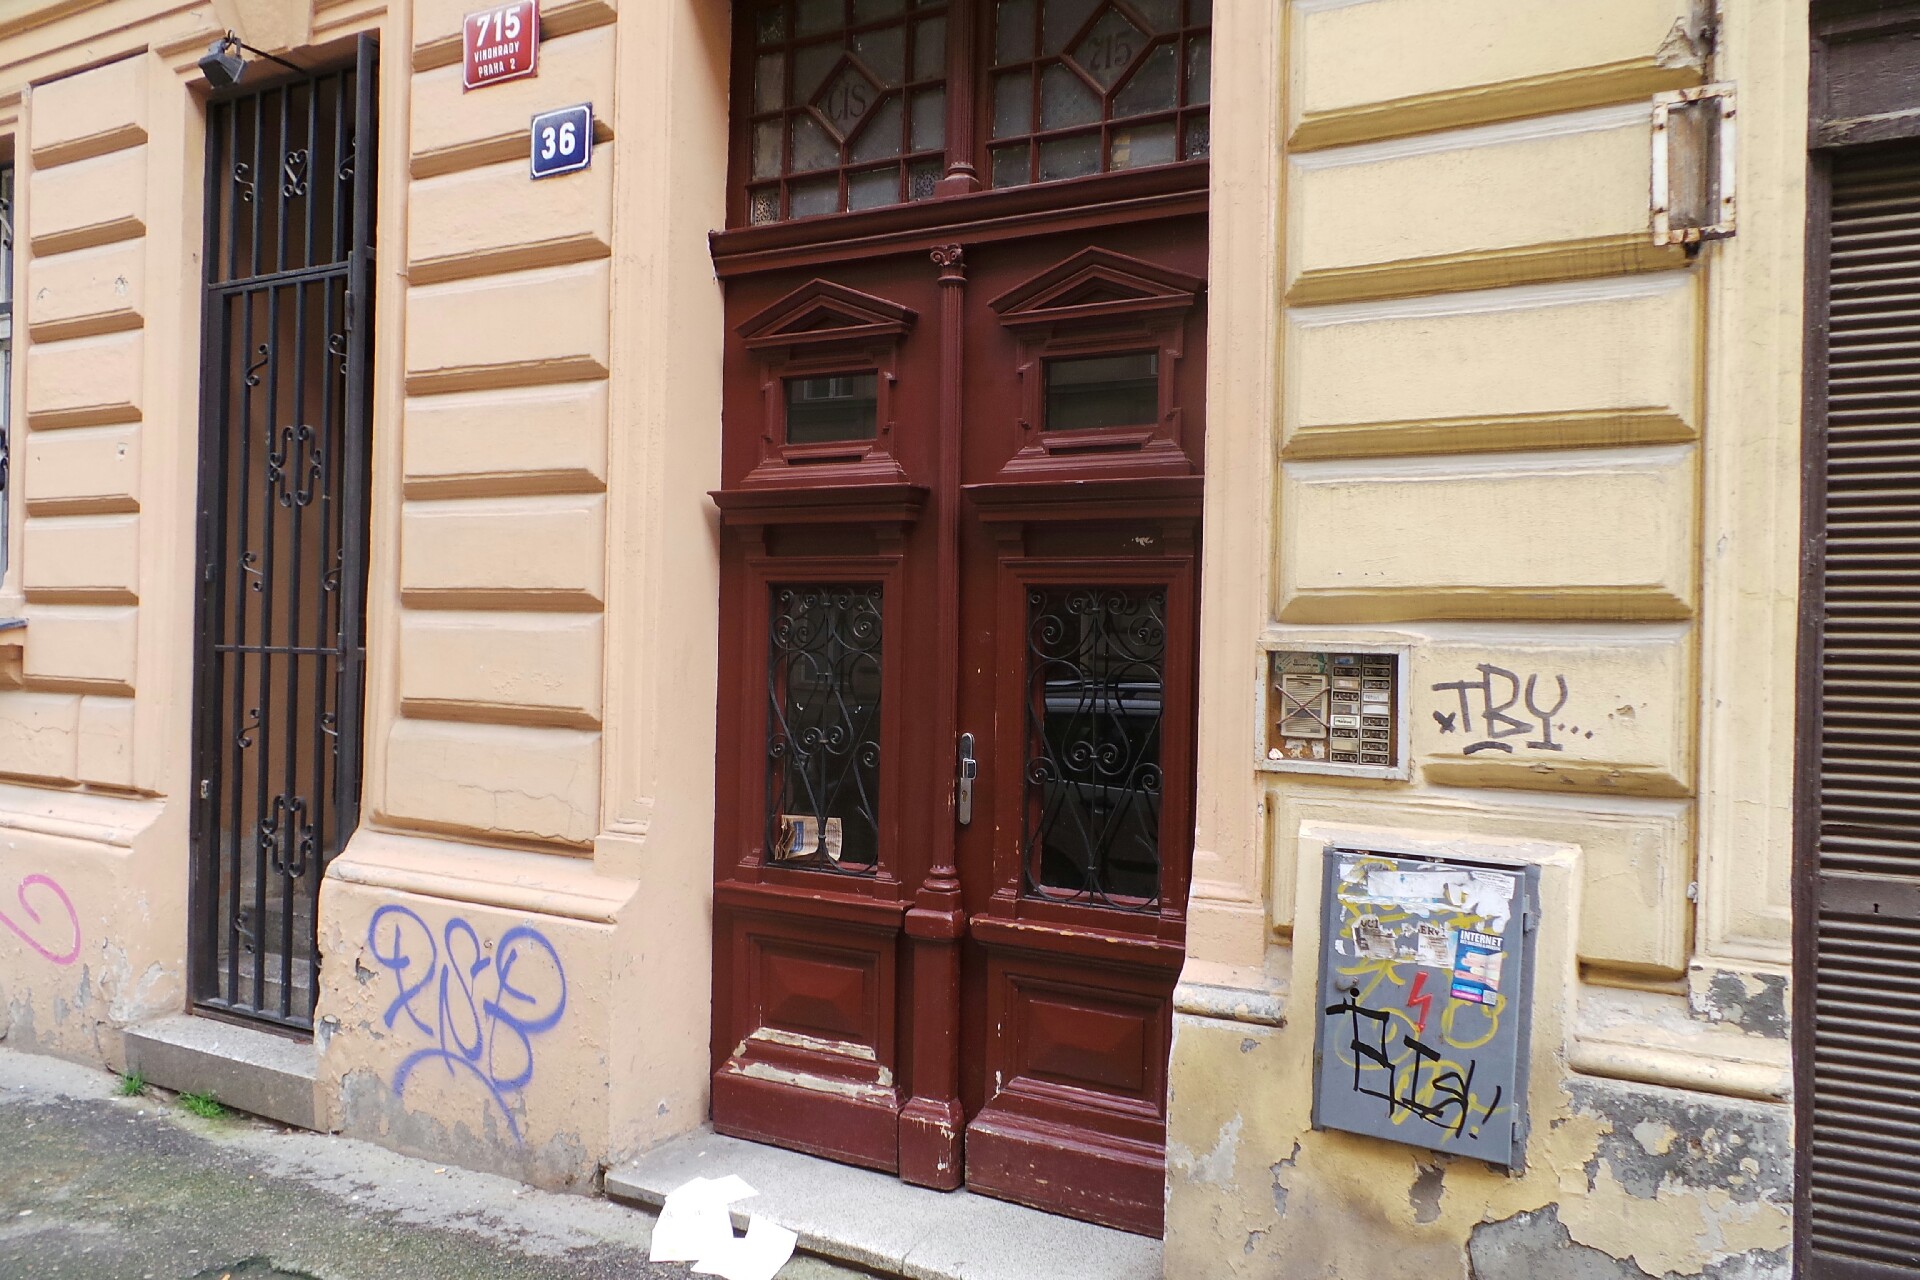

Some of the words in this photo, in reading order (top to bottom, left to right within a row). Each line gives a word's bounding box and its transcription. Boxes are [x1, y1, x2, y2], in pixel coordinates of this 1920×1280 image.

[476, 7, 521, 48] 715
[474, 41, 520, 63] VINOHRADY
[478, 60, 505, 78] PRAHA
[509, 57, 516, 70] 2
[541, 122, 576, 160] 36
[1461, 930, 1504, 947] INTERNET
